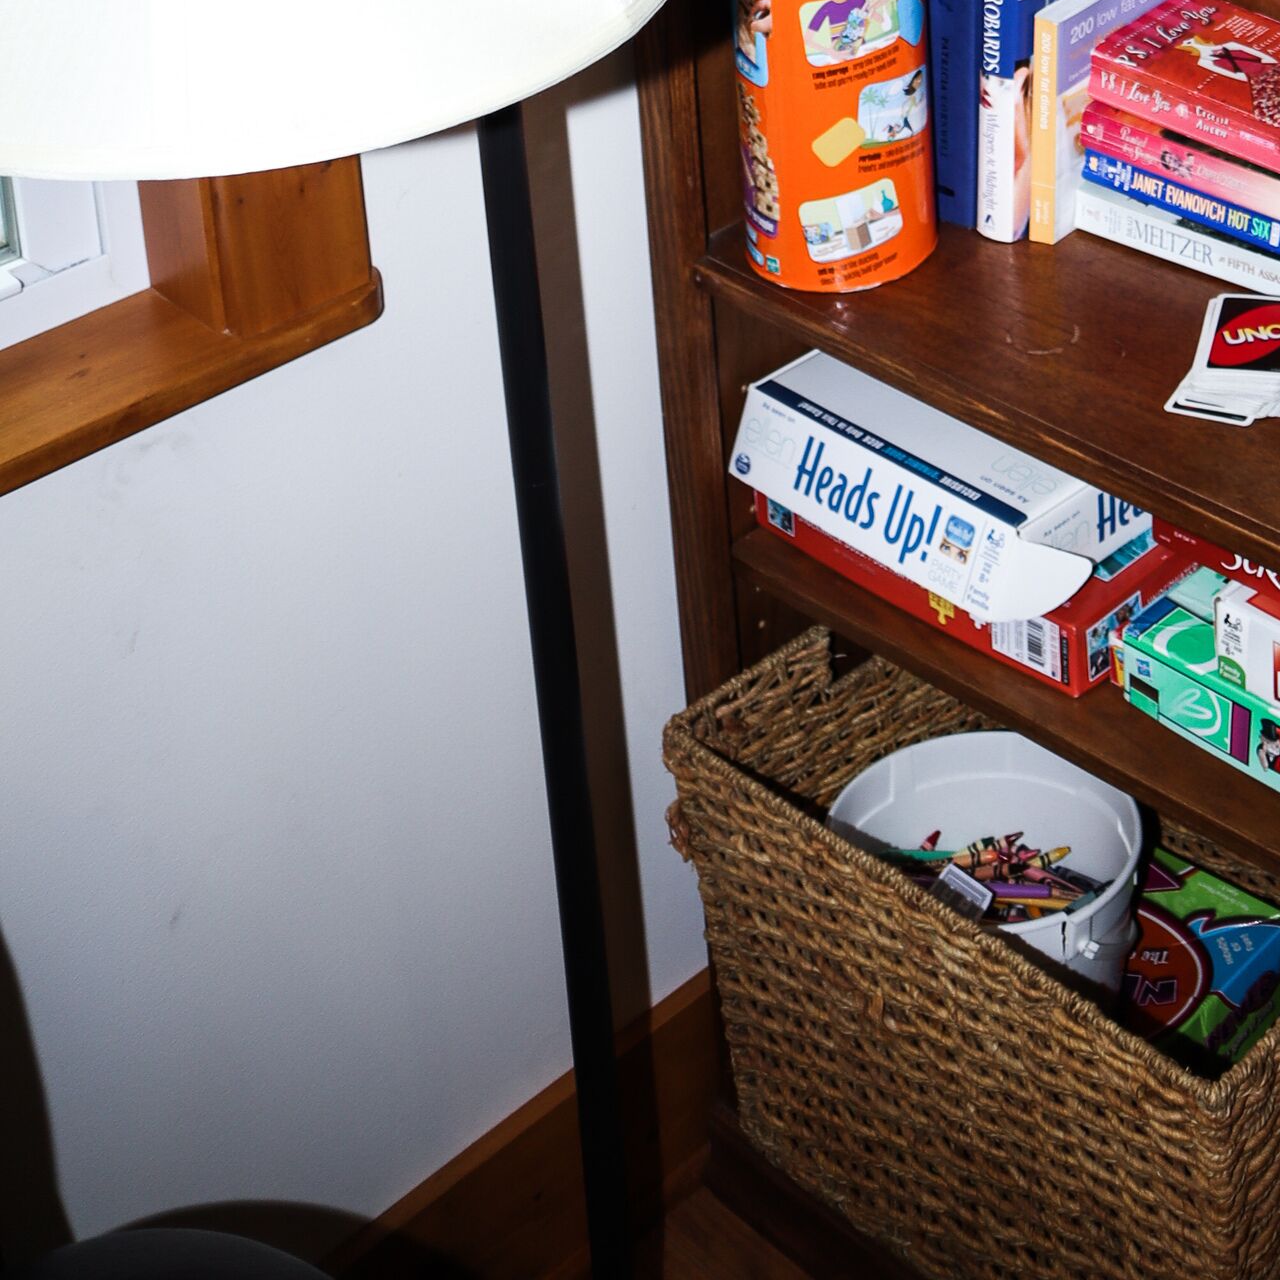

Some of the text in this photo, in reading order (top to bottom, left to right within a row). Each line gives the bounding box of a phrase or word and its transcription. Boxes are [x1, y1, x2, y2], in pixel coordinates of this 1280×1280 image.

[1070, 20, 1094, 45] 200
[1096, 7, 1118, 27] low
[1157, 19, 1191, 42] Love
[1182, 4, 1217, 26] You
[1042, 33, 1052, 52] 200
[1041, 53, 1051, 75] low
[1039, 93, 1050, 131] dishes
[1127, 81, 1150, 103] Love
[1151, 89, 1171, 113] You
[984, 114, 998, 155] Whispers
[1195, 118, 1228, 140] AHERN
[1131, 172, 1164, 200] JANET
[1165, 181, 1227, 223] EVANOVICH
[1227, 208, 1251, 234] HOT
[1251, 217, 1272, 239] SIX
[1134, 218, 1215, 267] MELTZER
[1226, 256, 1256, 276] FIFTH
[744, 415, 796, 463] ellen
[793, 435, 943, 565] Heads Up!
[930, 557, 964, 581] PARTY
